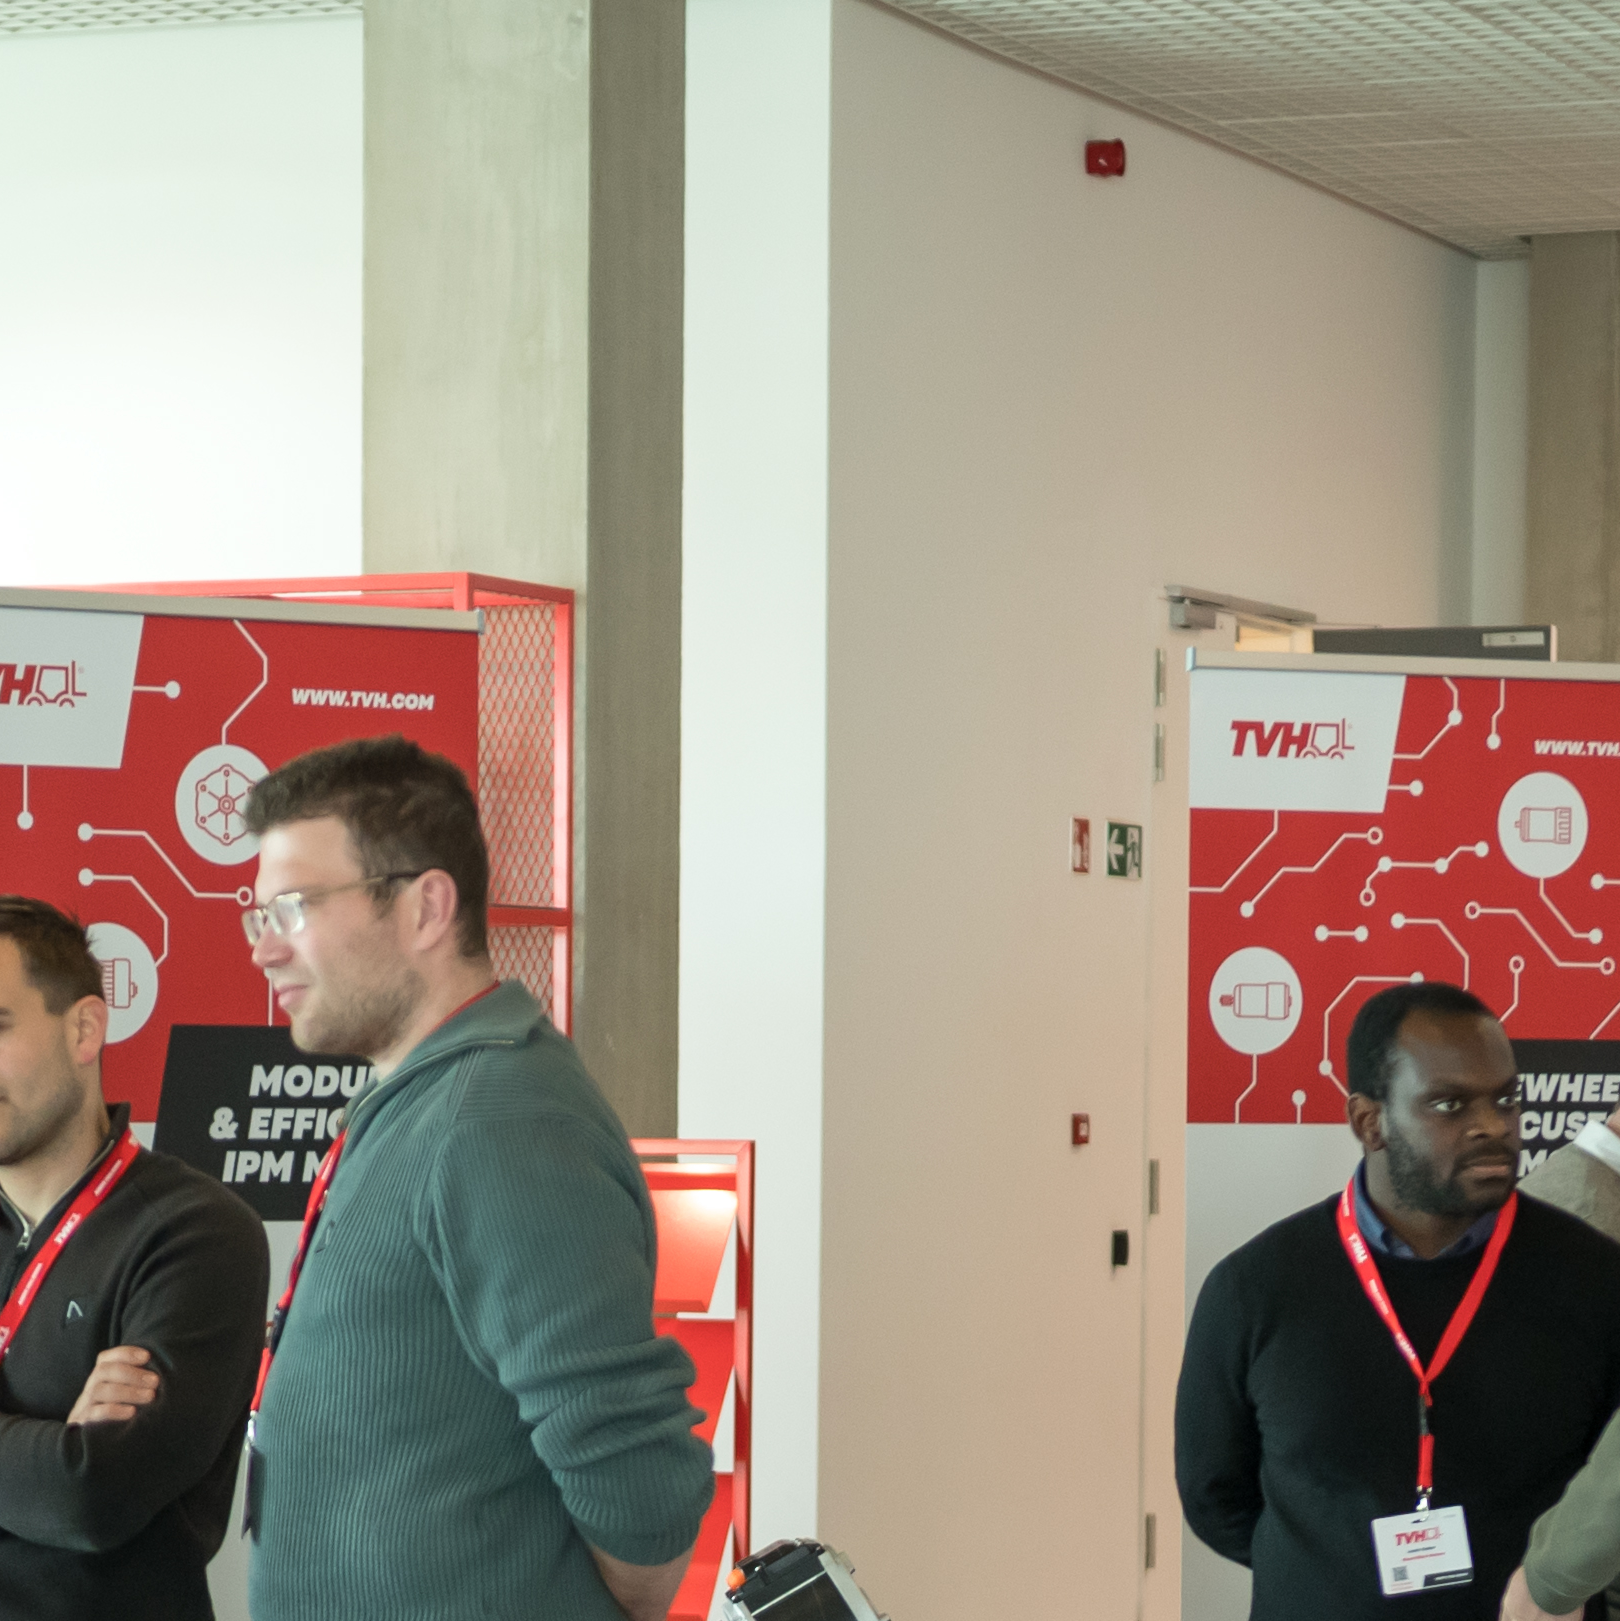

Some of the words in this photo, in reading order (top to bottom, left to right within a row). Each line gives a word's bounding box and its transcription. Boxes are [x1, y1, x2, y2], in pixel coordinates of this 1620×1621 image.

[291, 688, 435, 711] WWW.TVH.COM
[1230, 720, 1312, 758] TVH
[249, 1064, 376, 1098] MODU
[209, 1106, 239, 1140] &
[222, 1150, 295, 1183] IPM
[1395, 1528, 1427, 1547] TVH
